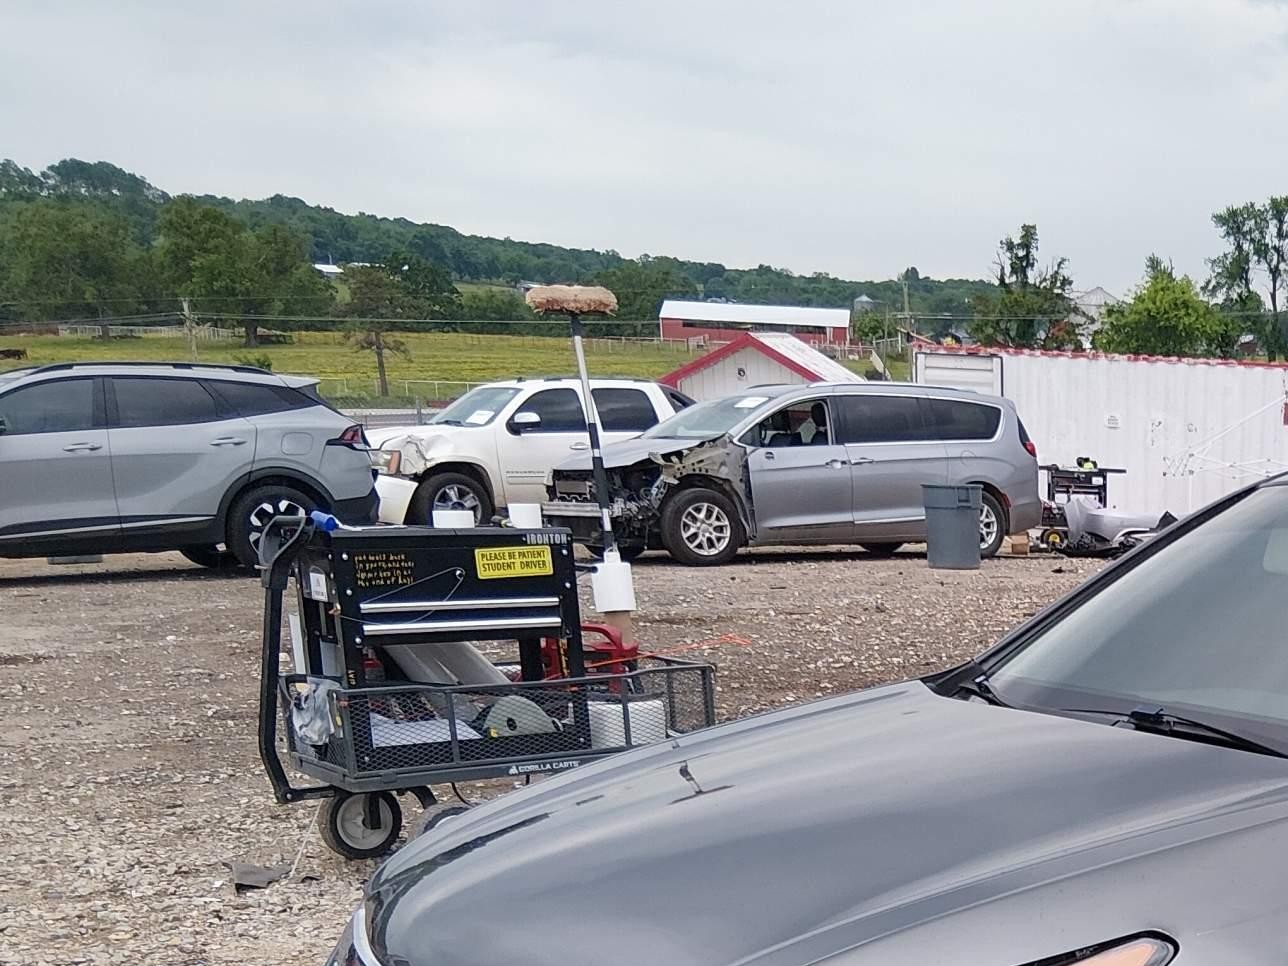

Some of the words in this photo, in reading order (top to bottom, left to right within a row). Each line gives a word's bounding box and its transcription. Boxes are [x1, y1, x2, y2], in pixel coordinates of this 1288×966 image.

[526, 533, 567, 545] IRONTON
[480, 551, 507, 562] PLEASE
[508, 551, 517, 560] BE
[518, 550, 546, 559] PATIENT
[482, 561, 516, 572] STUDENT
[520, 560, 547, 570] DRIVER
[518, 763, 552, 773] GORILLA
